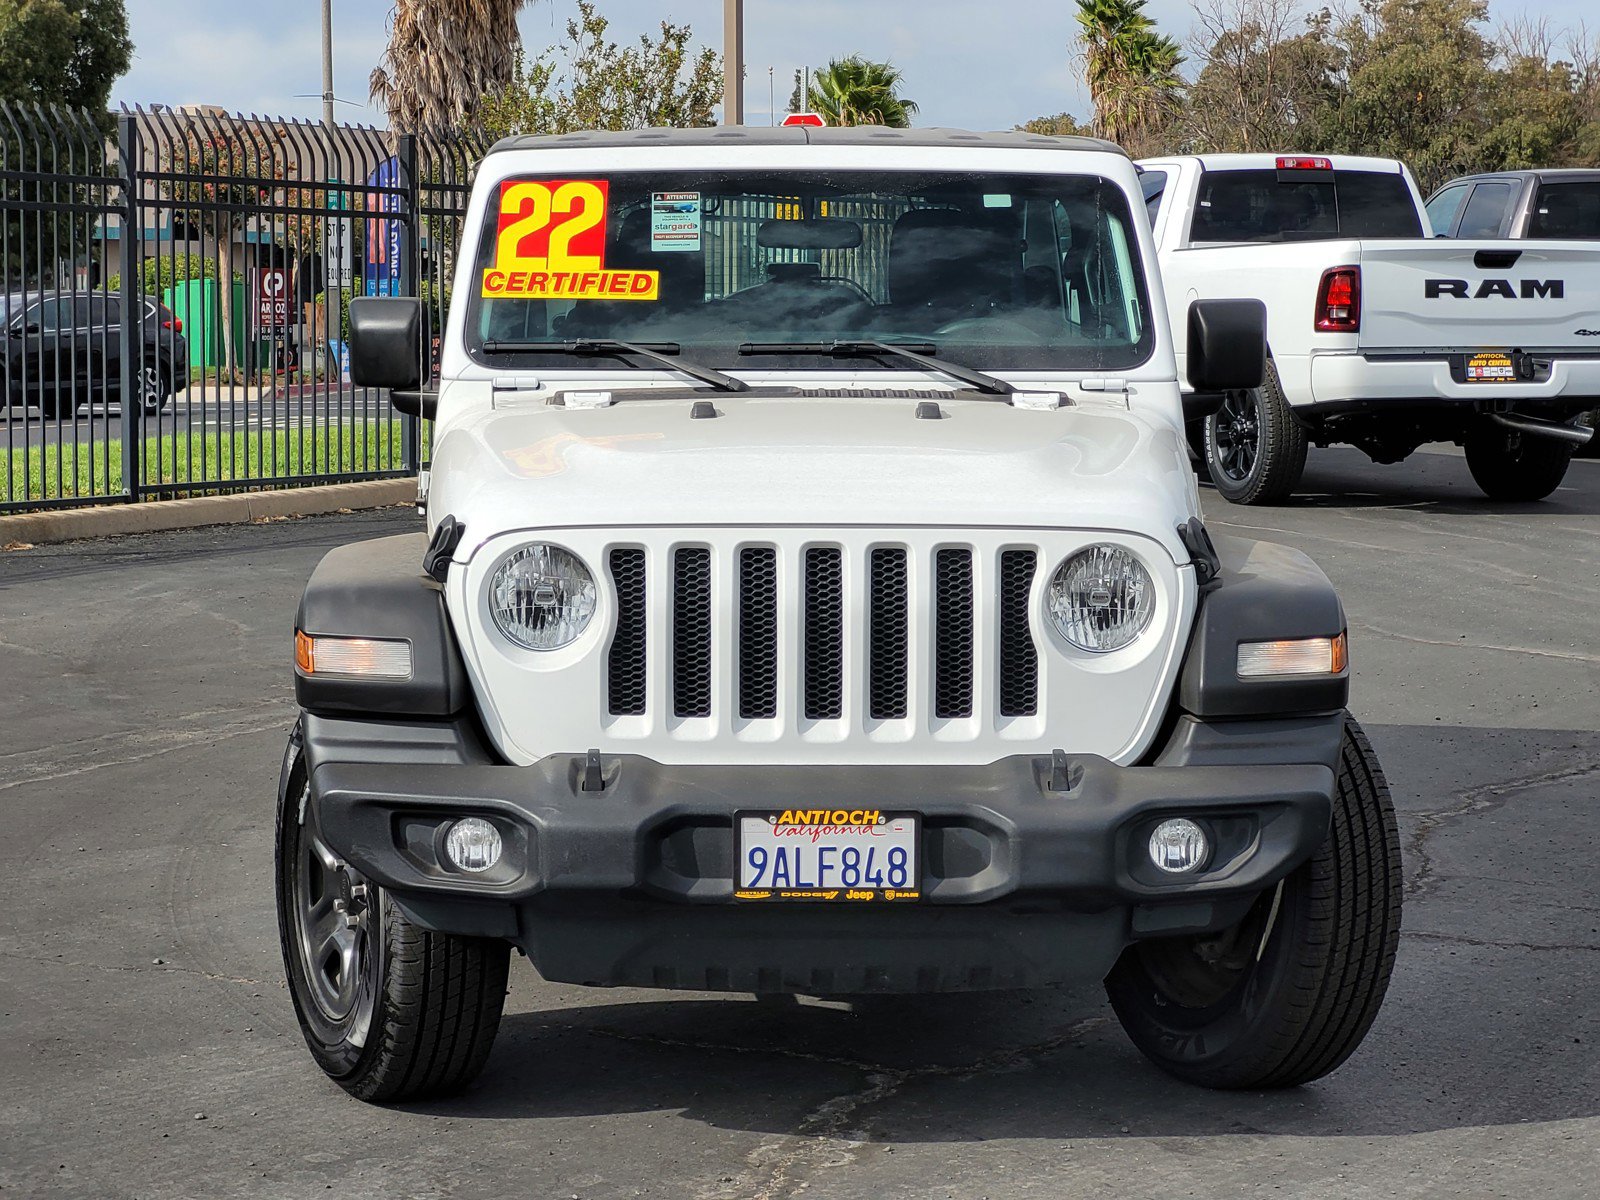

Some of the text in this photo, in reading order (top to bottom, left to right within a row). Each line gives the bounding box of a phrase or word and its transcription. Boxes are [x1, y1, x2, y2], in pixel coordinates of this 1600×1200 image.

[327, 223, 346, 237] STP
[496, 182, 604, 270] 22
[654, 222, 693, 231] stargard
[326, 267, 351, 280] EQURED
[484, 271, 655, 295] CERTIFIED
[1424, 279, 1564, 299] RAM
[1573, 329, 1600, 337] 4x
[1468, 359, 1512, 367] AUTO CENTER
[777, 810, 880, 825] ANTIOCH
[773, 824, 887, 844] California
[747, 846, 908, 888] 9ALF848
[845, 889, 875, 901] Jeep
